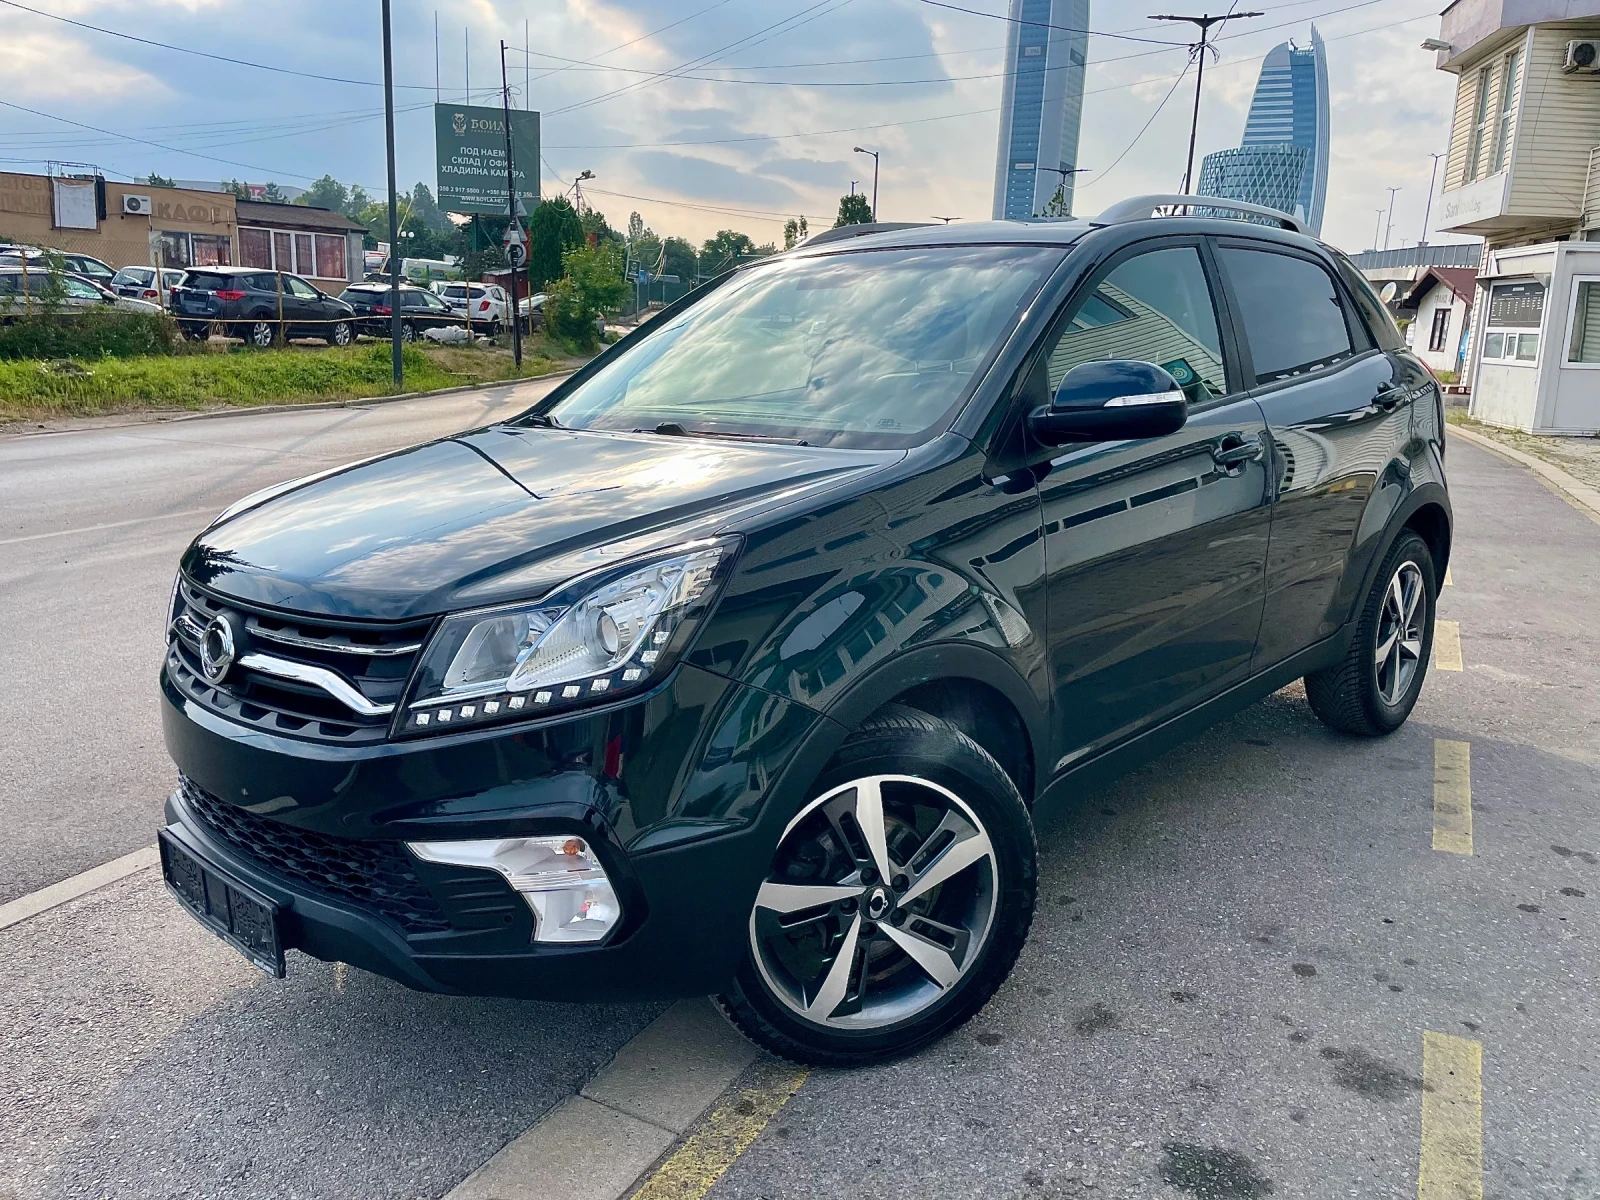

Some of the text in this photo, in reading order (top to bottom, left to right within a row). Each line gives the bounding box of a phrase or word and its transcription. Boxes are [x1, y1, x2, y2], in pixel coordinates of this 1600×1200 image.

[460, 147, 505, 157] ПОД НАЕМ
[451, 156, 481, 167] СКЛАД
[489, 159, 515, 168] ОФИ
[441, 165, 525, 178] ХЛАДИЛНА КАМРА
